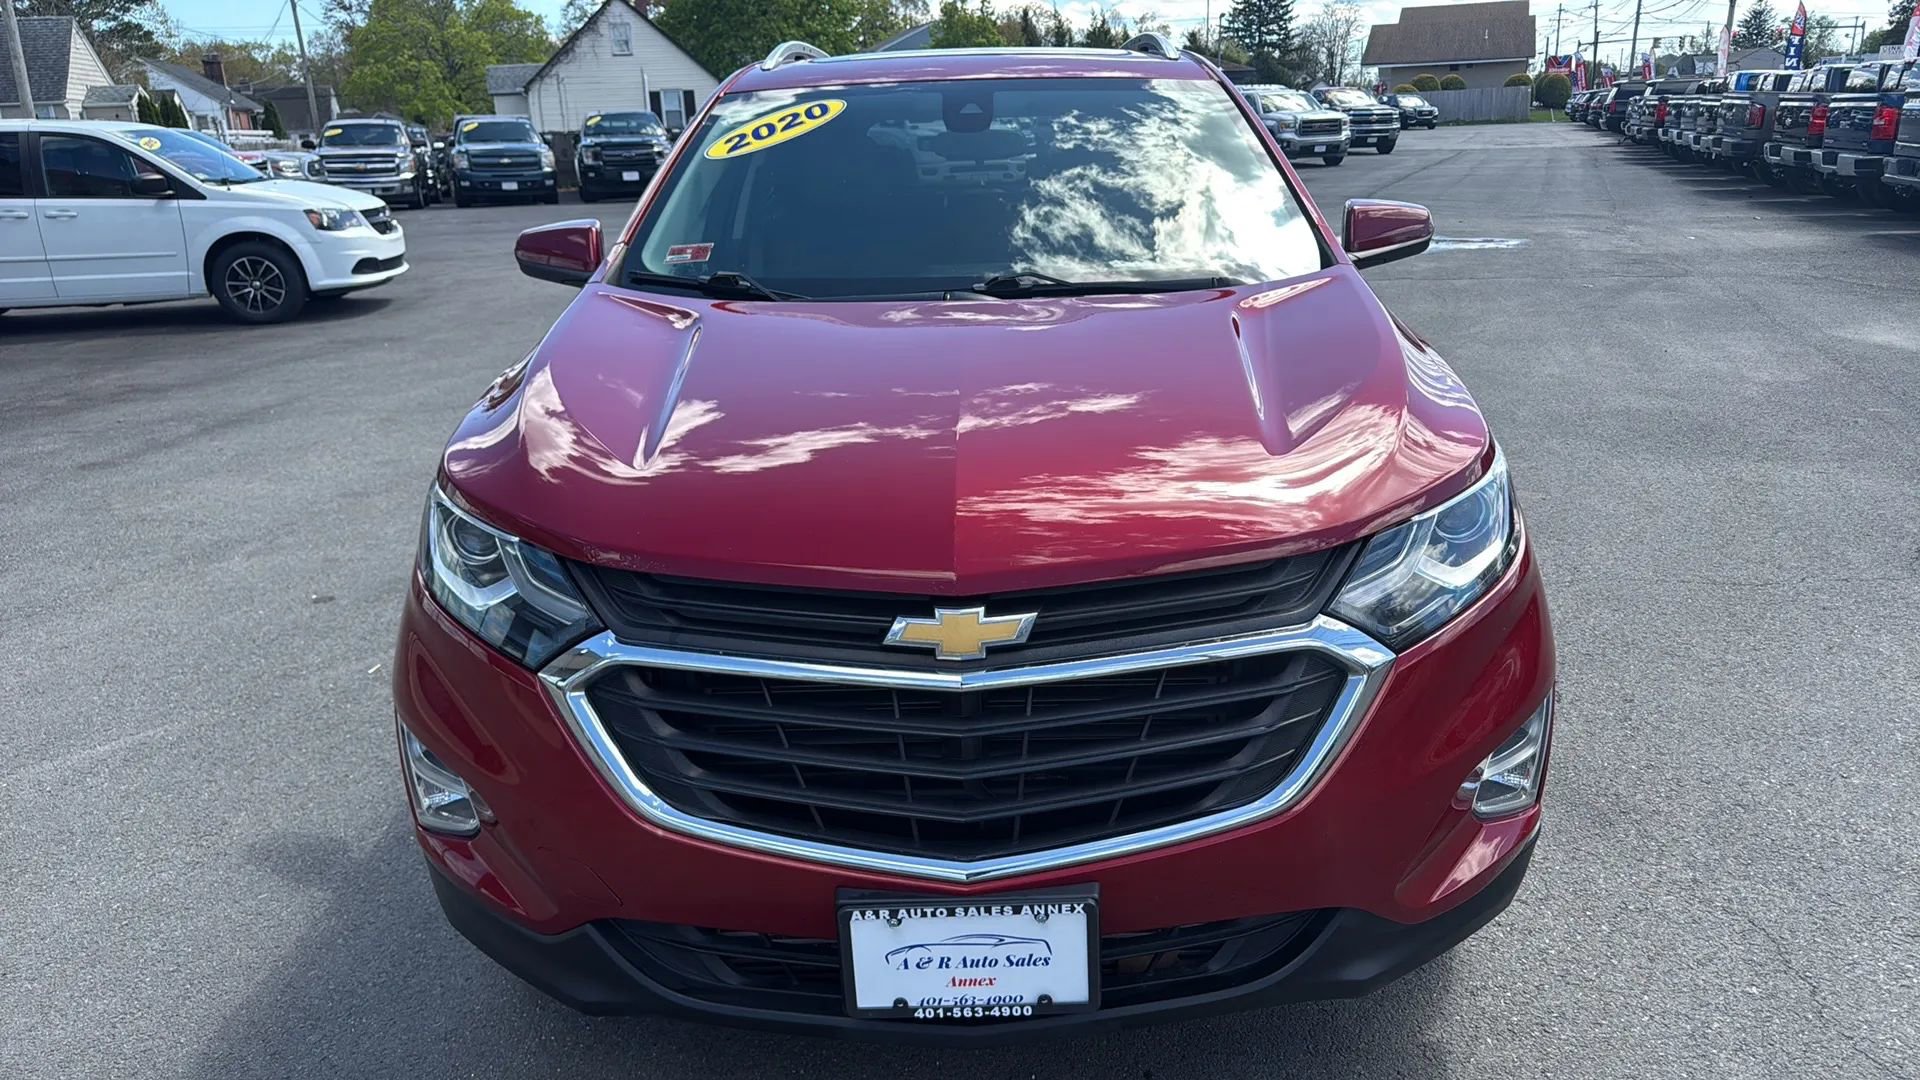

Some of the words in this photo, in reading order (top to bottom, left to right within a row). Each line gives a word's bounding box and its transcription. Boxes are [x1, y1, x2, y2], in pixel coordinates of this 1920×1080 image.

[723, 103, 830, 155] 2020
[851, 910, 890, 921] A&R
[898, 908, 947, 919] AUTO
[955, 905, 1013, 917] SALES
[1021, 903, 1085, 915] ANNEX
[896, 960, 909, 971] A
[915, 957, 934, 969] &
[936, 956, 953, 969] R
[955, 955, 999, 969] Auto
[1003, 953, 1052, 968] Sales
[946, 976, 996, 988] Annex
[918, 993, 1024, 1006] 401-563-4900
[914, 1006, 1033, 1018] 401-563-4900
